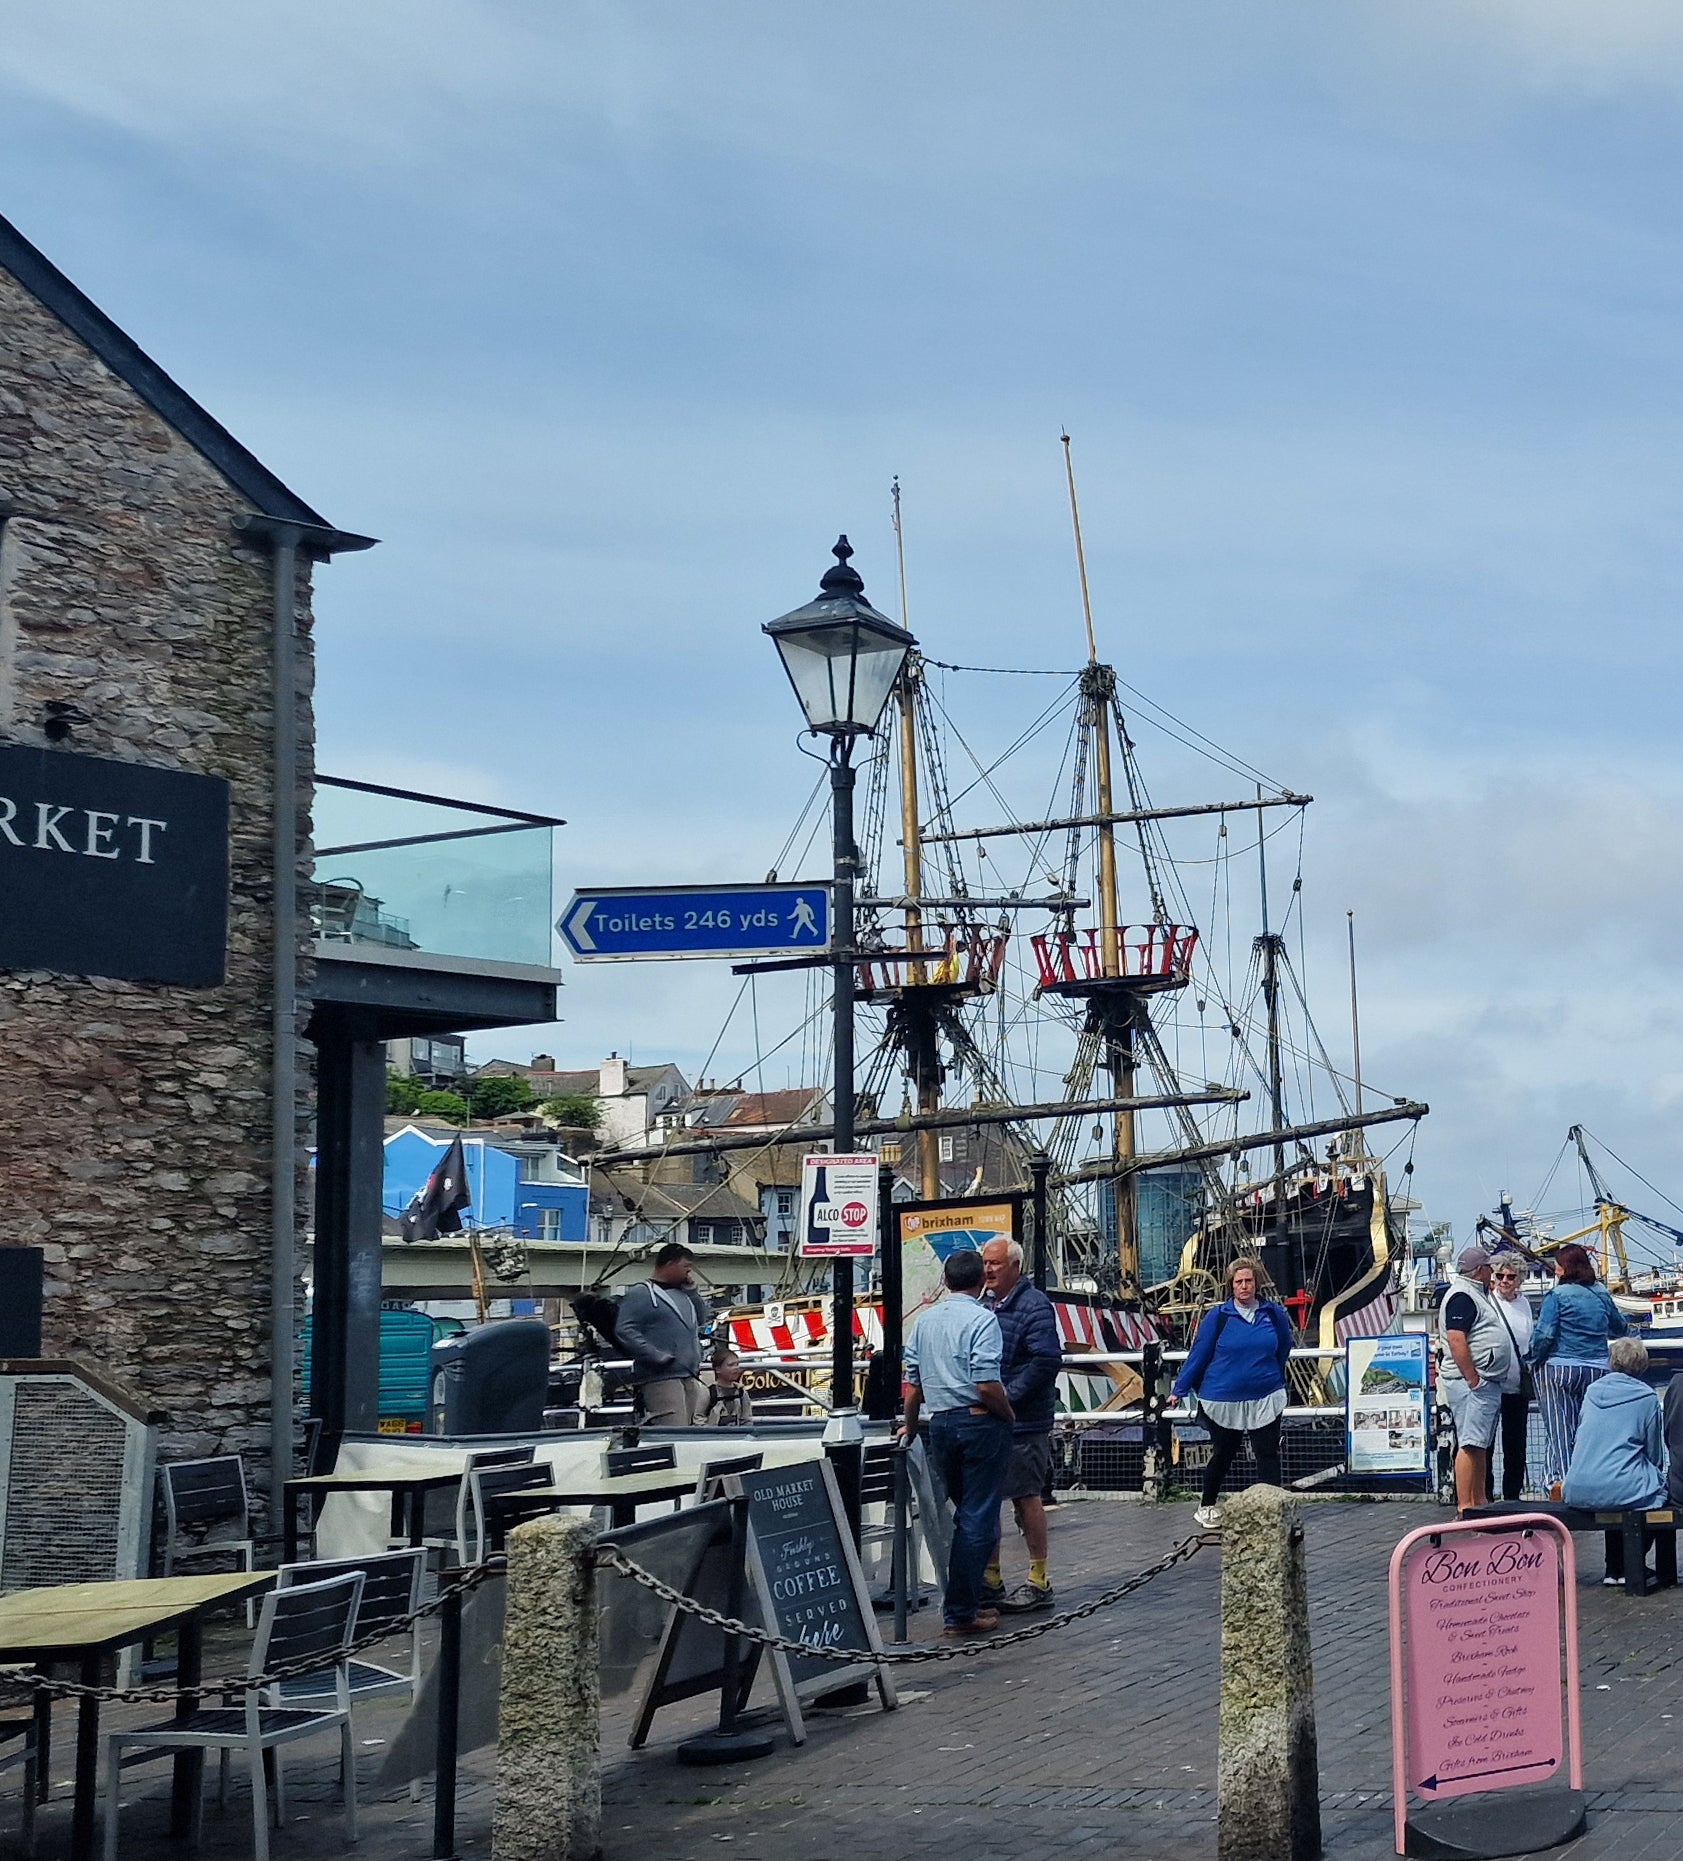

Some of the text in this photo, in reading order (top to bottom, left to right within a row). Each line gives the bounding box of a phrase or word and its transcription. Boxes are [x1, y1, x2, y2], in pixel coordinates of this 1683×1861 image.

[0, 796, 168, 864] RKET
[594, 909, 779, 933] Toilets 246 yds
[817, 1208, 867, 1221] ALCO STOP
[922, 1216, 974, 1228] brixham
[753, 1479, 814, 1502] OLD MARKET
[772, 1496, 804, 1511] HOUSE
[777, 1552, 831, 1573] GROUND
[1421, 1541, 1544, 1584] Bon Bon
[773, 1565, 841, 1600] COFFEE
[1442, 1575, 1522, 1592] CONFECTIONERY
[1430, 1595, 1483, 1611] Traditional
[785, 1598, 847, 1627] SERVED
[1451, 1650, 1493, 1663] Brixham
[1443, 1670, 1496, 1685] Handmade
[1502, 1705, 1527, 1719] Gifts
[1464, 1733, 1488, 1746] Cold
[1489, 1728, 1524, 1742] Drinks
[1439, 1758, 1466, 1771] Gifts
